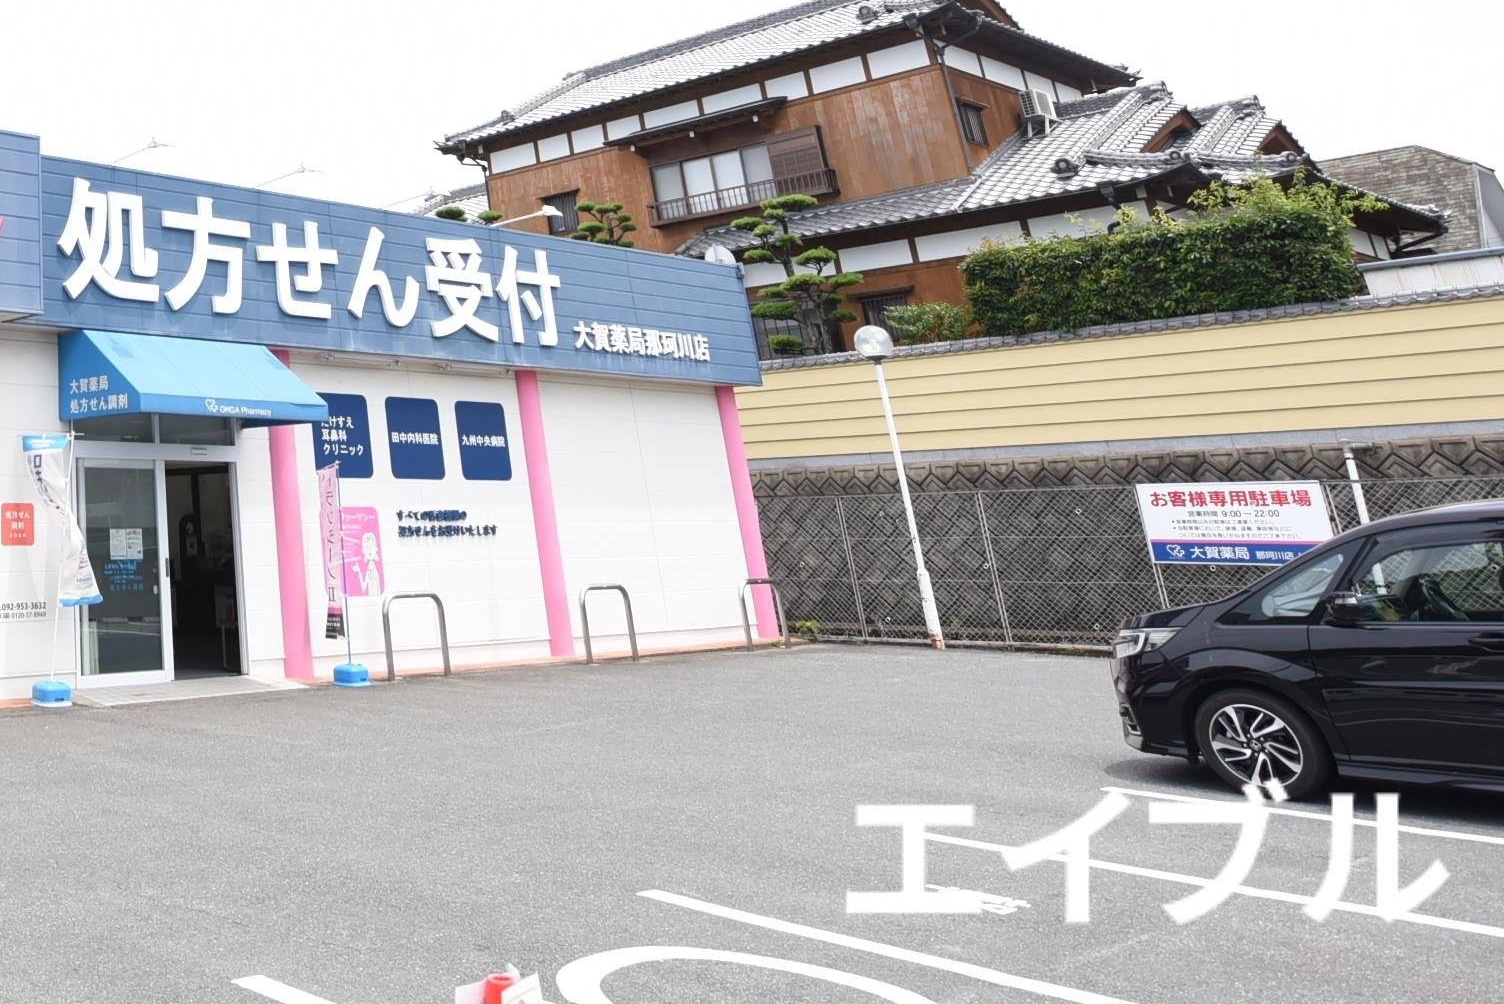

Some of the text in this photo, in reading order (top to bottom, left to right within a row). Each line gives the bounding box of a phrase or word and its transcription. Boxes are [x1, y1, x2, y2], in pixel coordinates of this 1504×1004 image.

[57, 177, 562, 347] 処方せん受付
[573, 320, 711, 362] 大賀薬局那珂川店
[70, 375, 109, 394] 大賀薬局
[70, 392, 128, 414] 処方せん調剤
[219, 404, 272, 417] OHGA Pharmacy
[323, 443, 364, 456] クリニック
[1150, 489, 1312, 507] お客様専用駐車場
[1222, 510, 1241, 518] 9:00
[1189, 546, 1294, 560] 大賀薬局 那珂川店
